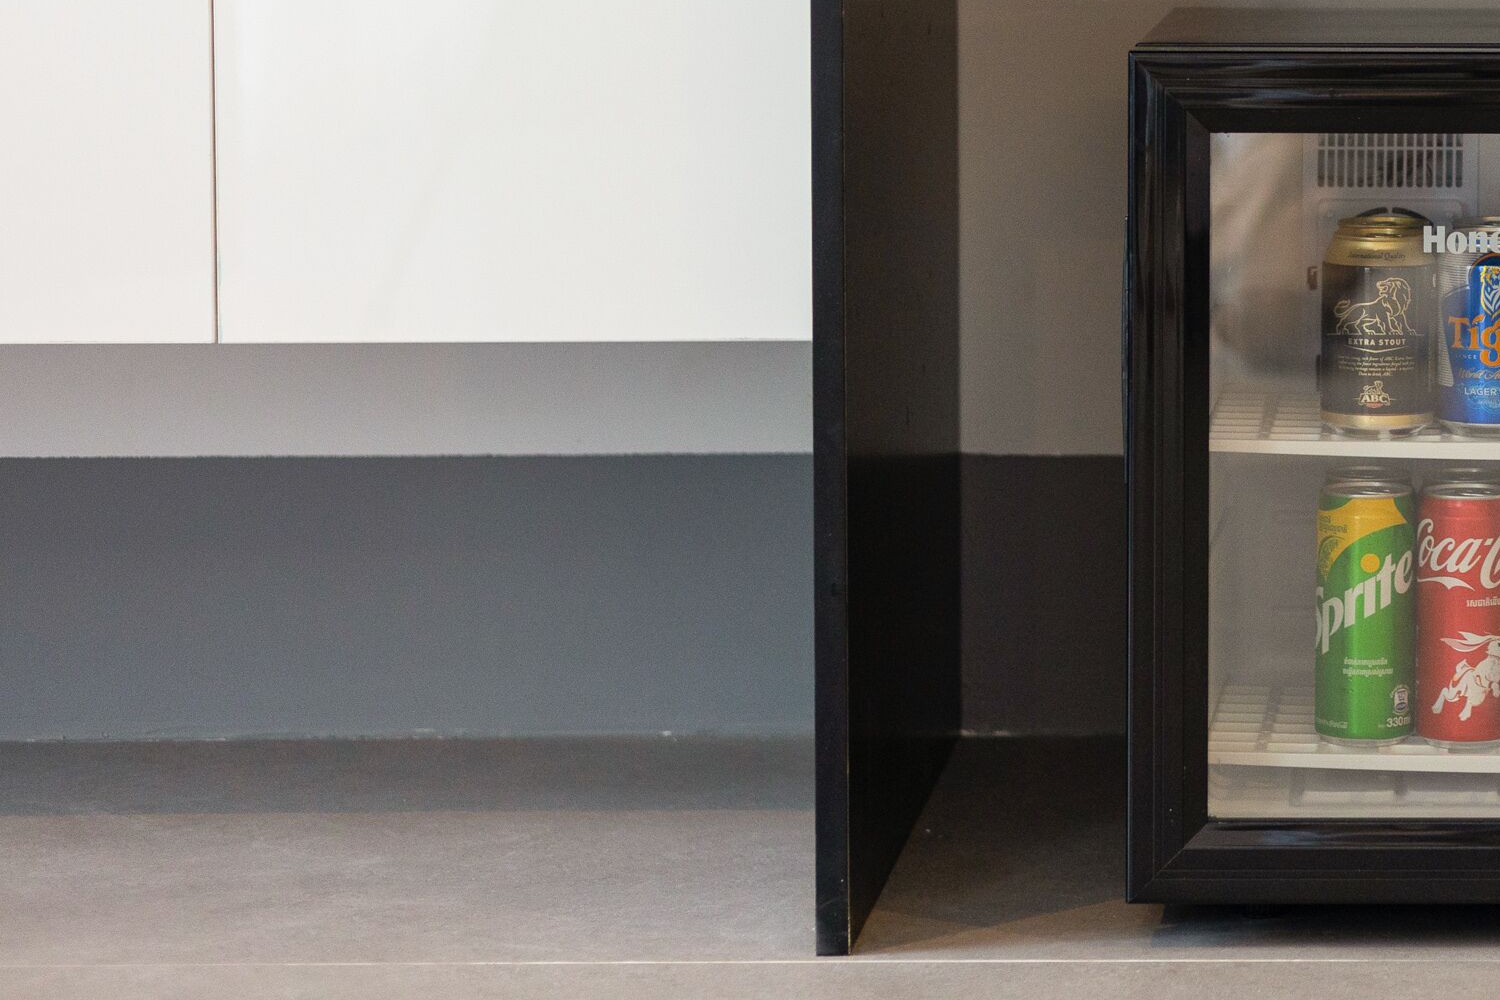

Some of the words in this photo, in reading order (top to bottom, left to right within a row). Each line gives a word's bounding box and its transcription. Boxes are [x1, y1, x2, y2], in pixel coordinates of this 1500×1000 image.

[1348, 338, 1375, 346] EXTRA
[1379, 338, 1406, 346] STOUT
[1464, 387, 1497, 396] LAGER
[1361, 394, 1388, 403] ABC
